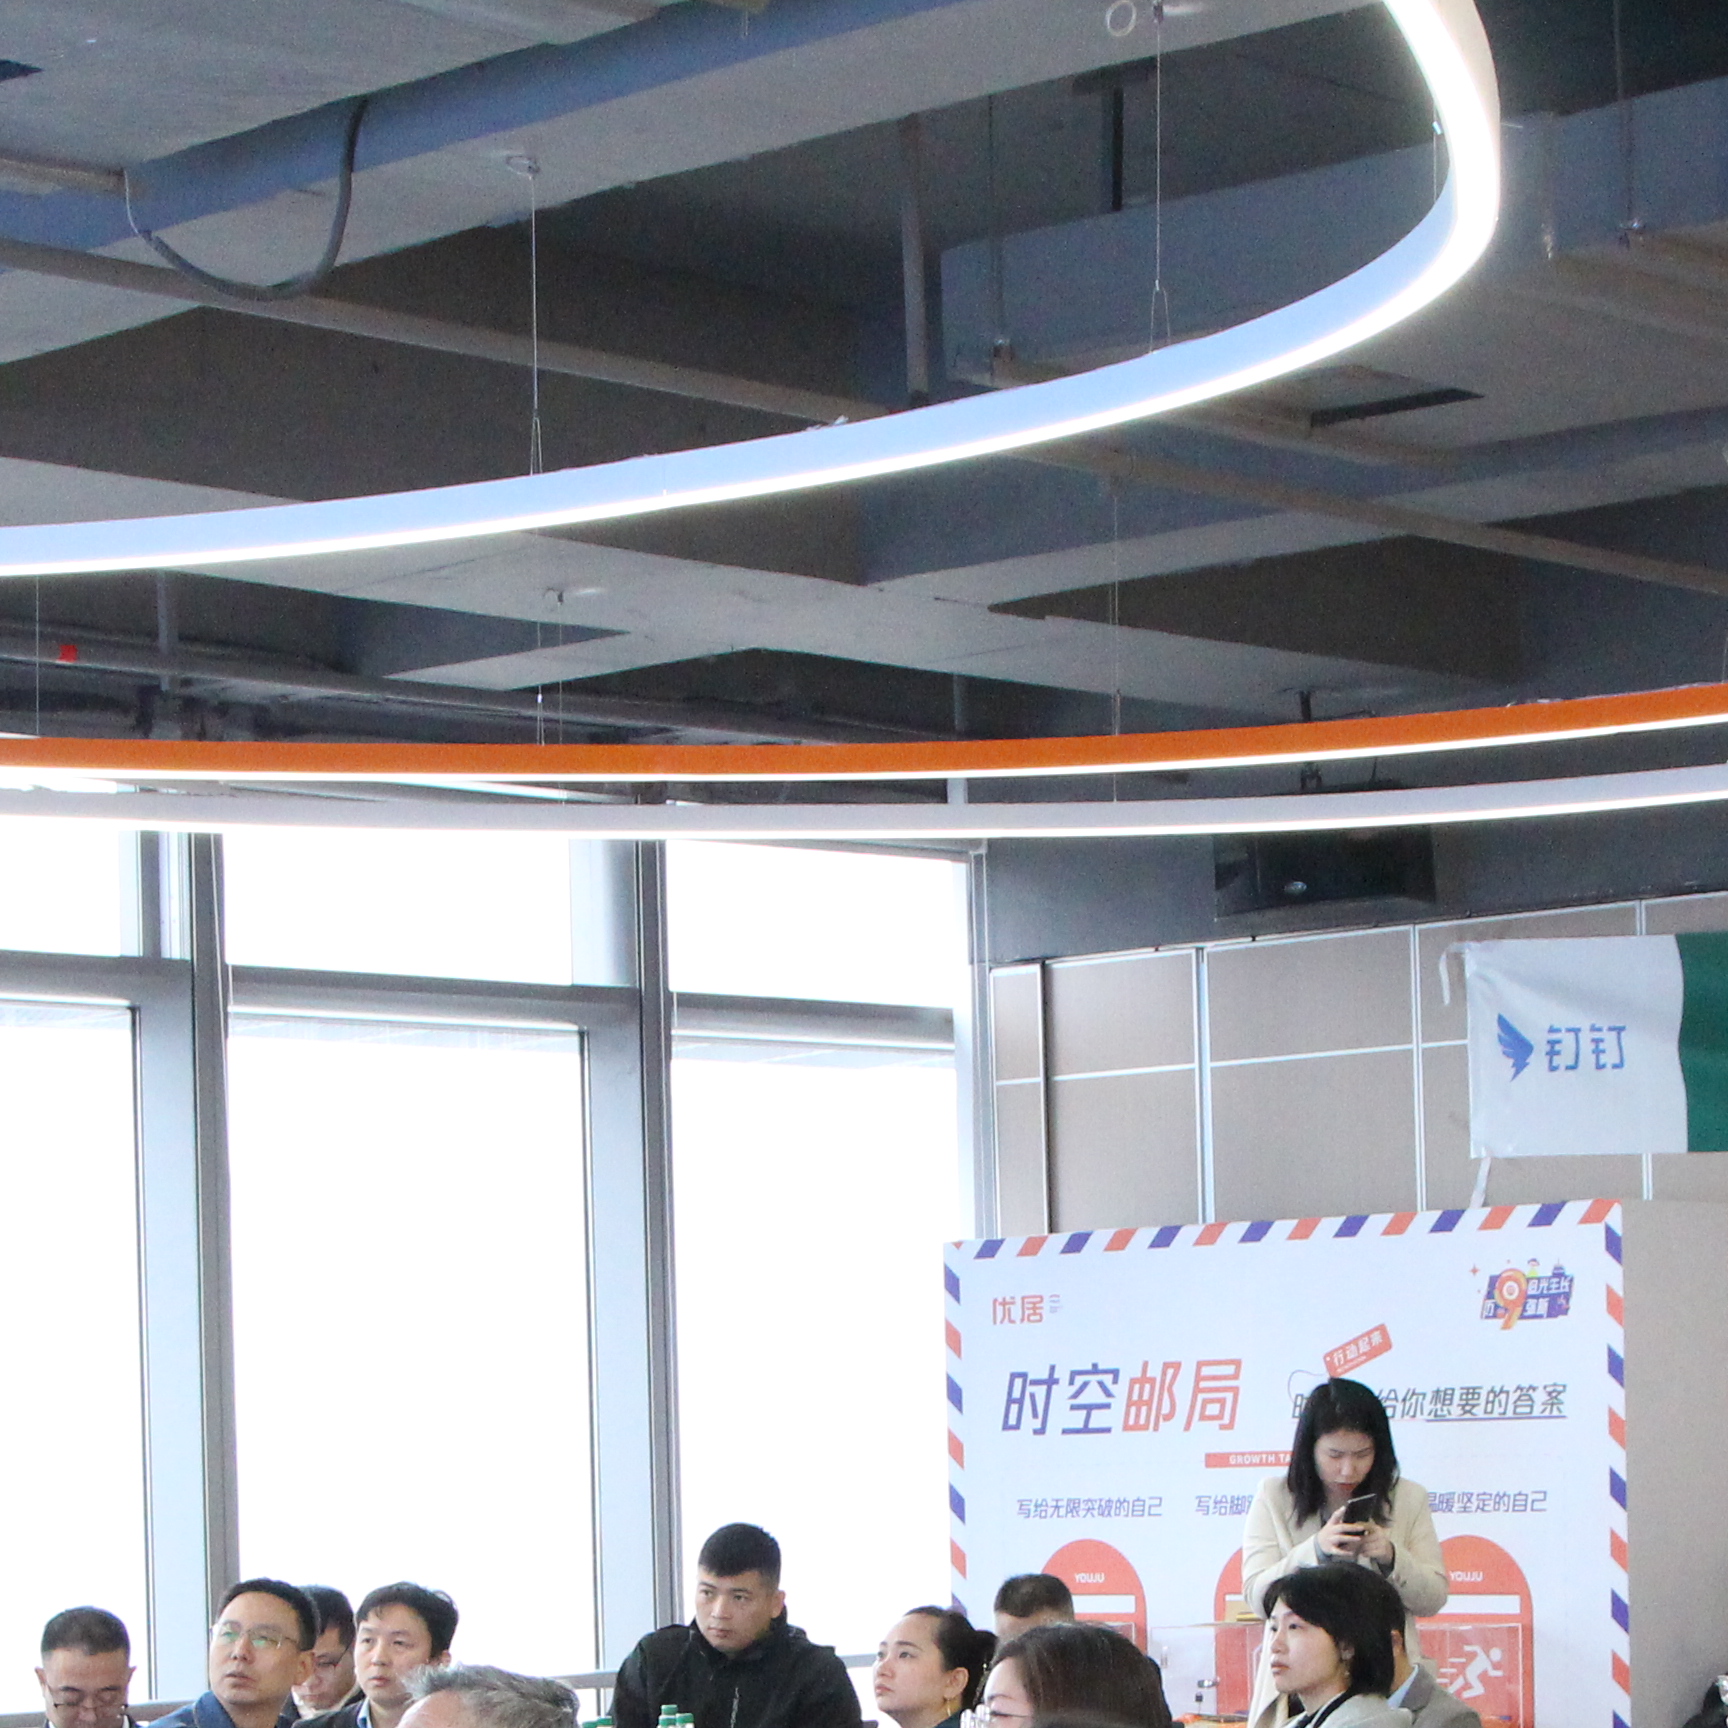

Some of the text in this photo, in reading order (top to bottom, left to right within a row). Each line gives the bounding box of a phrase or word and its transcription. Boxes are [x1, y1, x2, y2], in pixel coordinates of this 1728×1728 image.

[1545, 1023, 1627, 1072] 钉钉
[992, 1295, 1045, 1325] 优居
[1332, 1329, 1383, 1368] 行动起来
[1001, 1358, 1243, 1436] 时空邮局
[1229, 1454, 1276, 1465] GROWTH
[1016, 1496, 1163, 1519] 写给无限突破的自己
[1074, 1572, 1106, 1583] YOUJU
[1450, 1570, 1484, 1582] YOUJU
